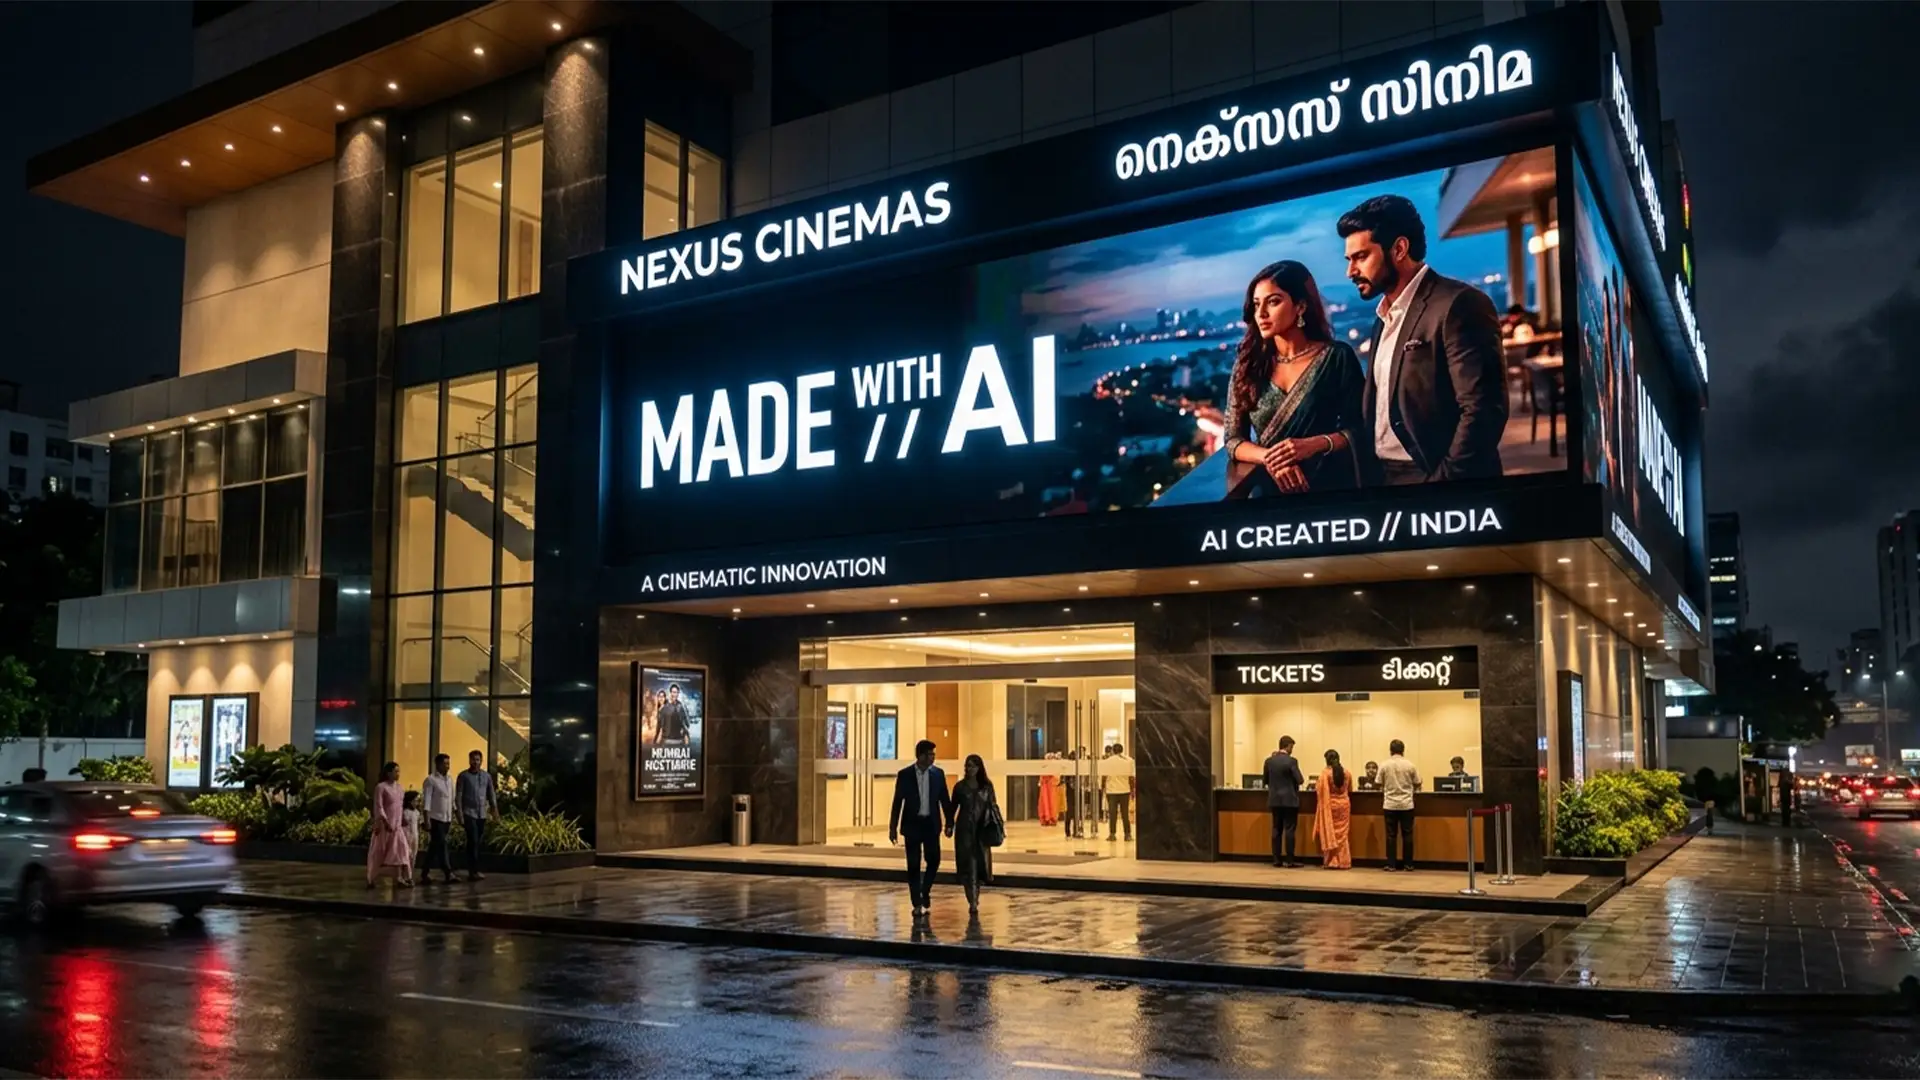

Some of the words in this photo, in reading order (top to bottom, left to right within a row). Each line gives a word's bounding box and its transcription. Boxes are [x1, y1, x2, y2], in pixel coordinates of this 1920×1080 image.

[1360, 43, 1533, 124] സിനിമ
[620, 231, 744, 295] NEXUS
[755, 181, 951, 263] CINEMAS
[640, 370, 836, 489] MADE
[851, 353, 942, 408] WITH
[941, 334, 1056, 454] AI
[1200, 529, 1227, 552] AI
[1236, 518, 1371, 549] CREATED
[1411, 507, 1502, 536] INDIA
[640, 575, 654, 593] A
[658, 566, 756, 591] CINEMATIC
[761, 556, 886, 584] INNOVATION
[1237, 663, 1325, 684] TICKETS
[1381, 655, 1454, 686] ടിക്കറ്റ്
